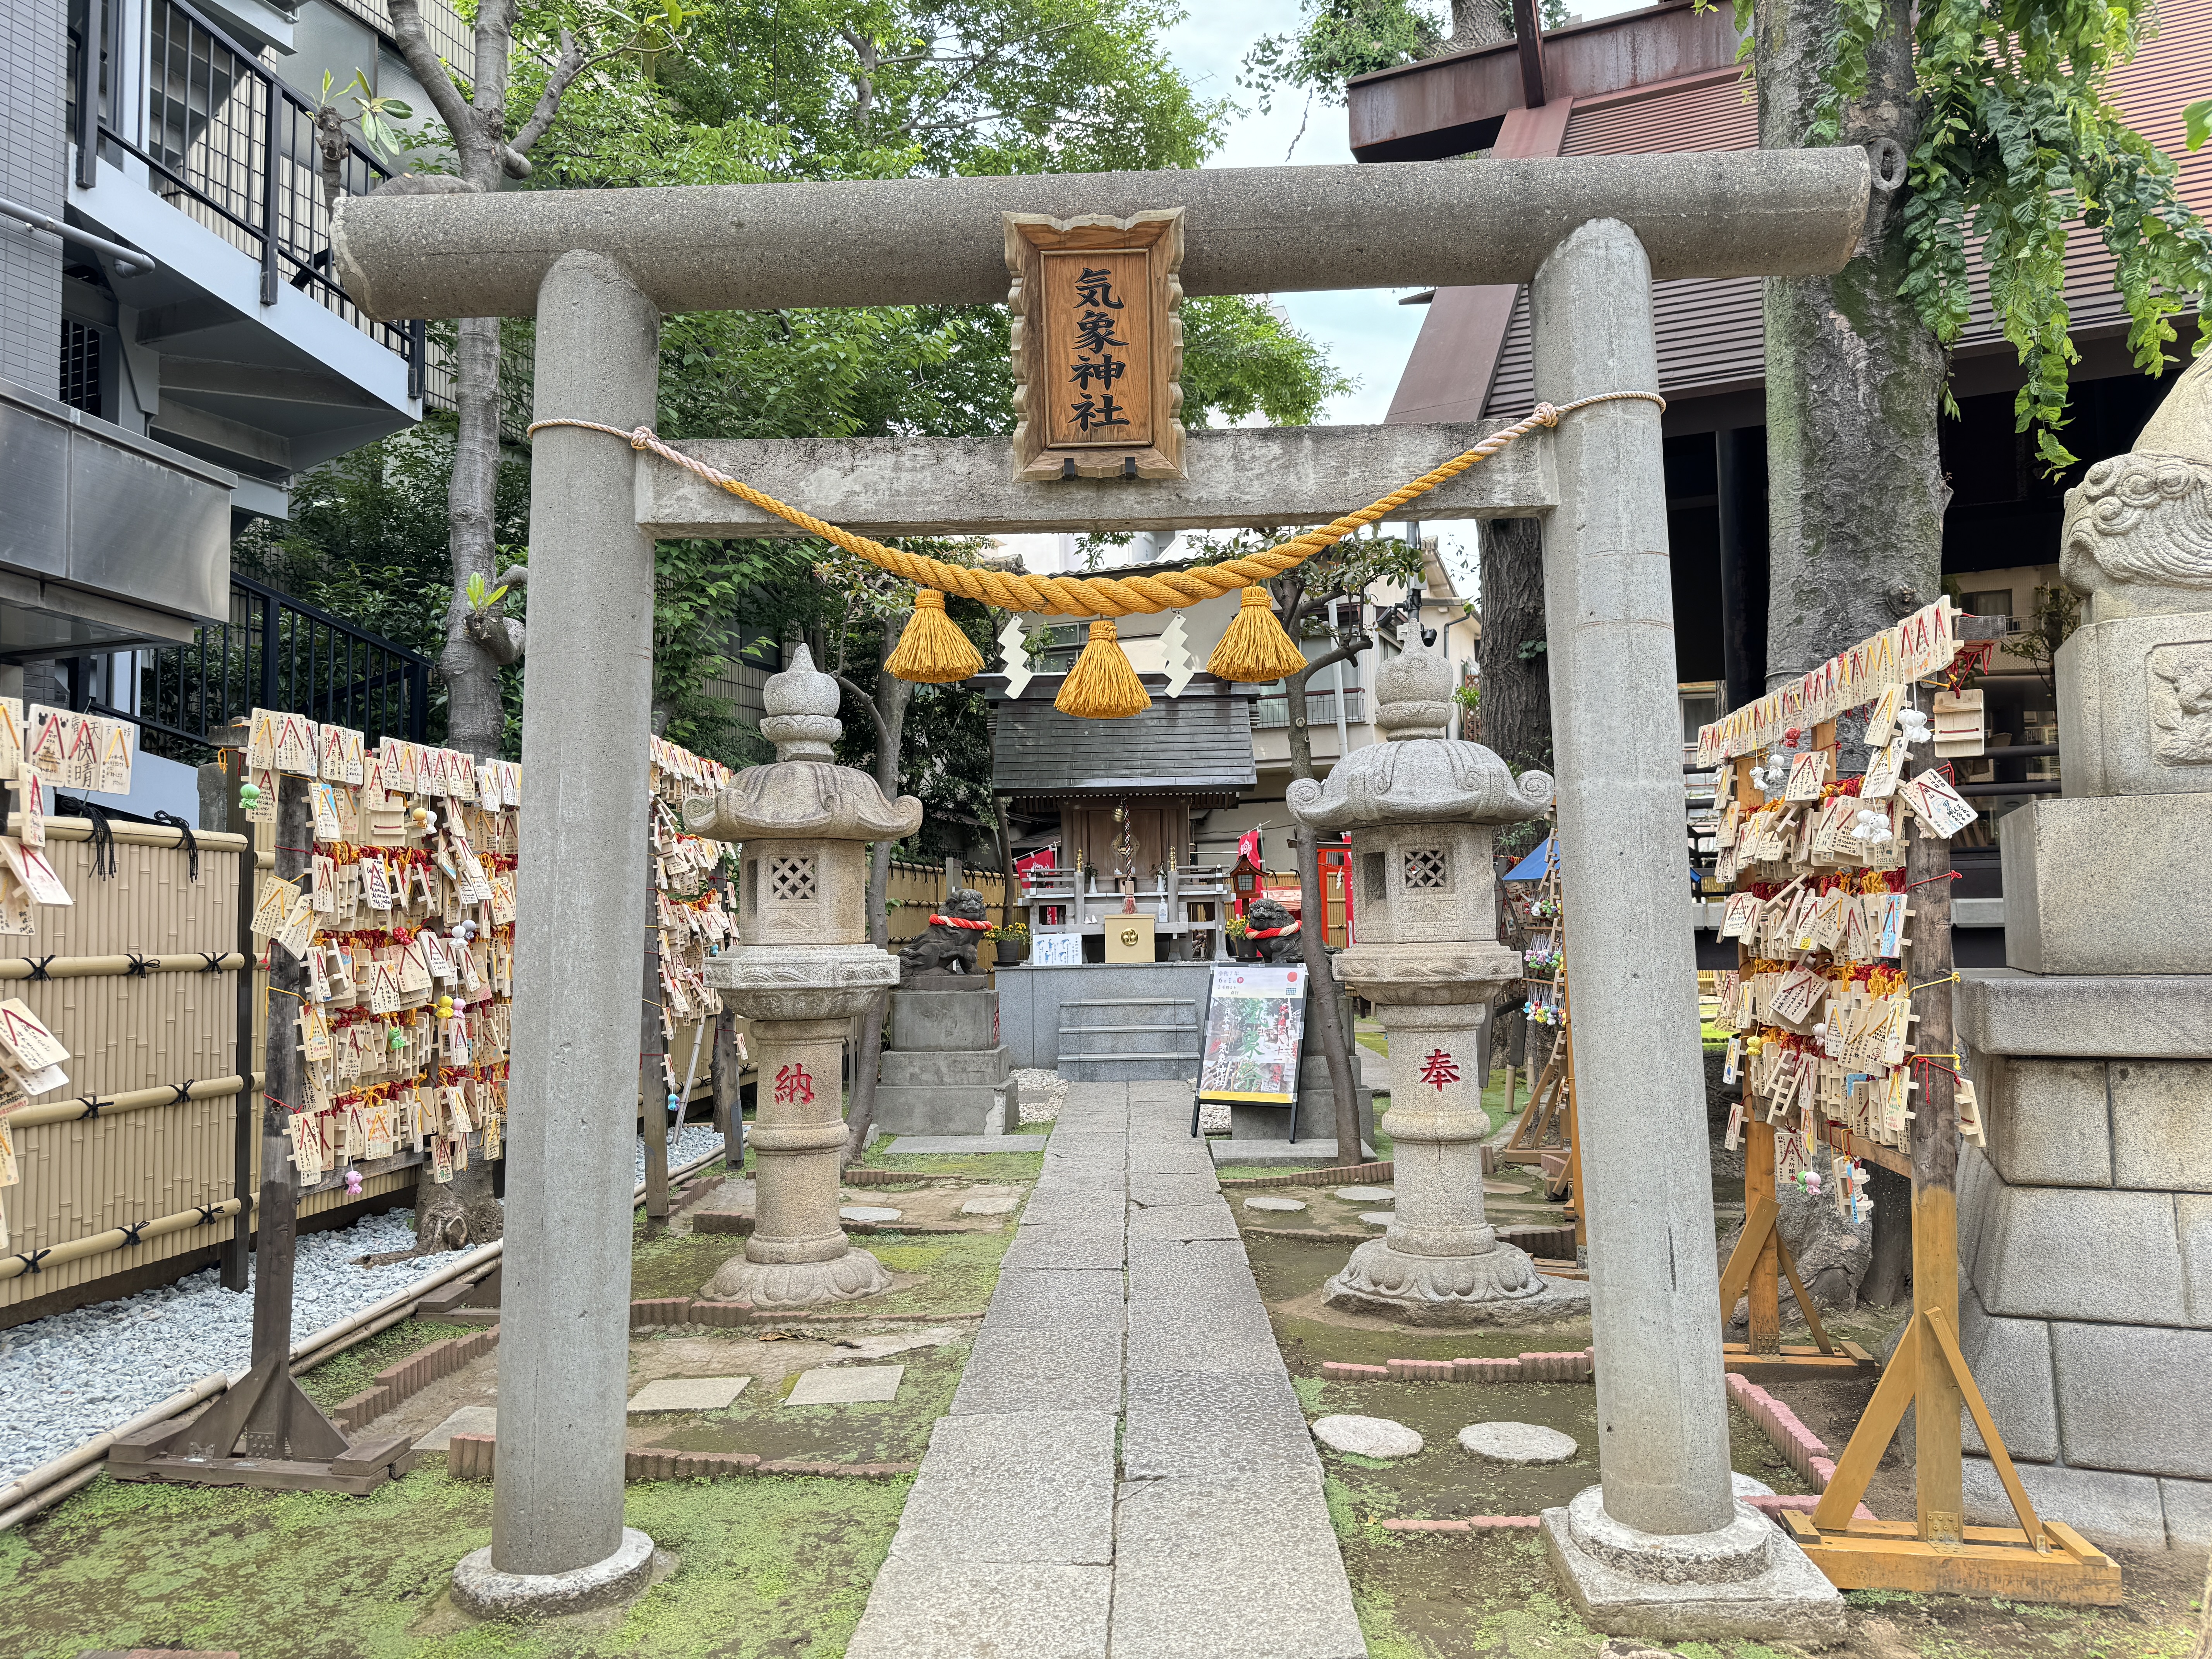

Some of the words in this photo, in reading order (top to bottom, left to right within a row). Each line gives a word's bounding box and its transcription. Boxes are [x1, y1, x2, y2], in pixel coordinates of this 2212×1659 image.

[1068, 267, 1130, 432] 気象神社
[775, 1063, 814, 1104] 納
[1214, 1042, 1229, 1087] 気象神社
[1420, 1048, 1460, 1092] 奉
